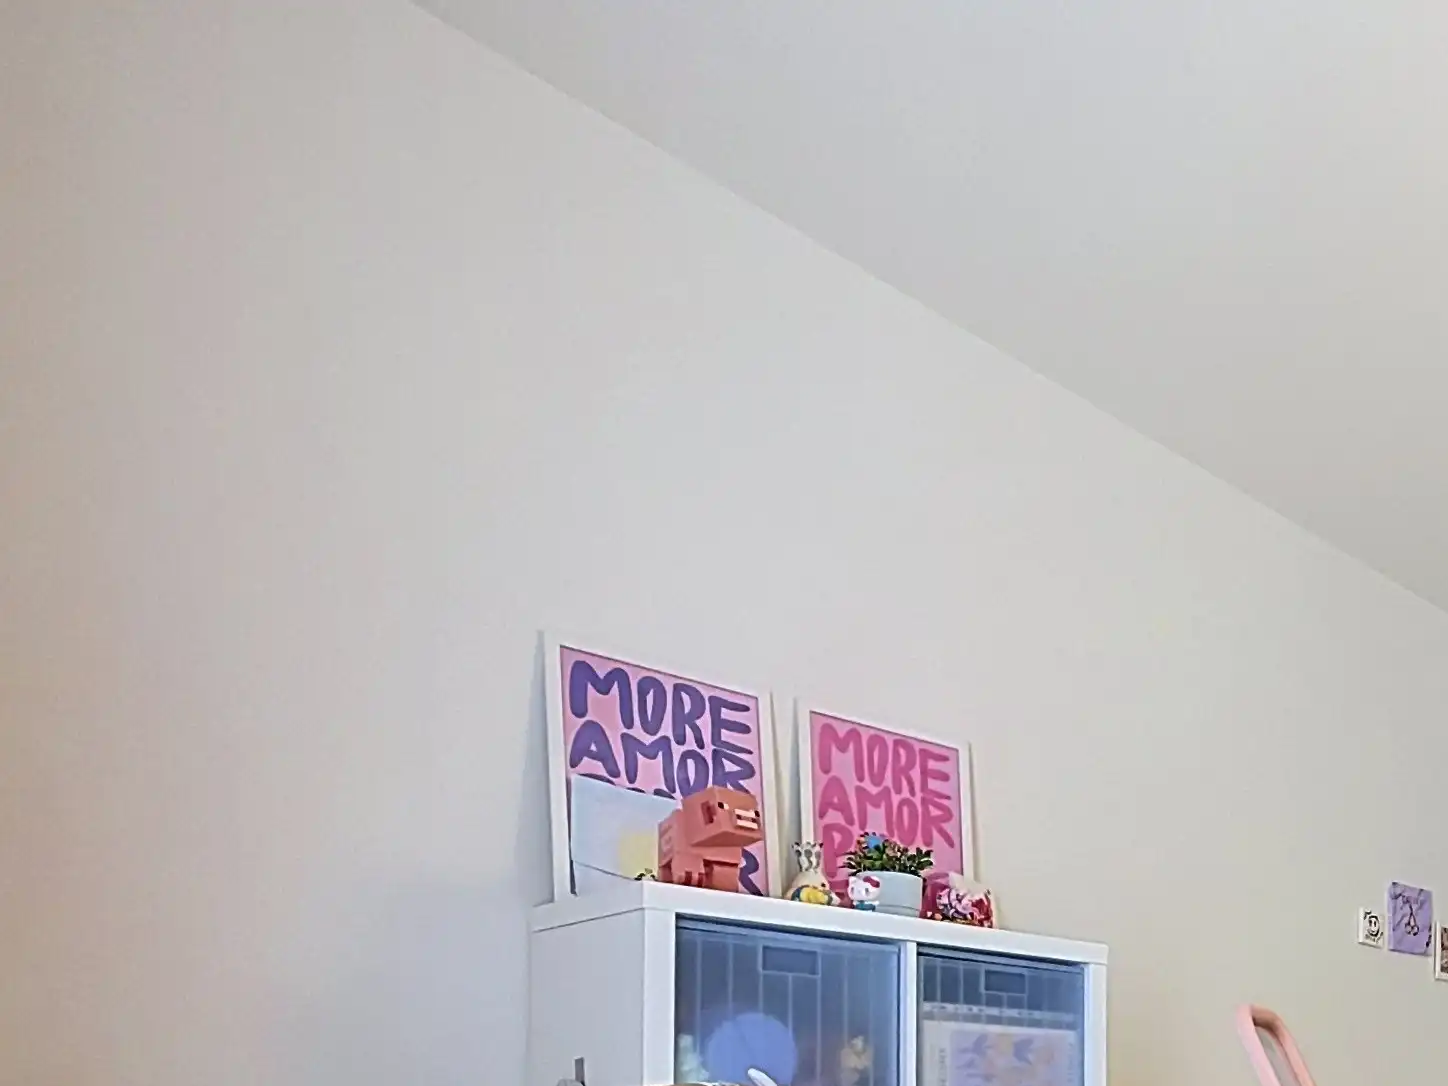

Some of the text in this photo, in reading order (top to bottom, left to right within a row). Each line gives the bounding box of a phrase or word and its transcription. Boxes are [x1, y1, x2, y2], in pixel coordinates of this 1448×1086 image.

[569, 660, 753, 755] MORE
[569, 720, 755, 798] AMOR
[818, 722, 951, 800] MORE
[818, 775, 954, 848] AMOR
